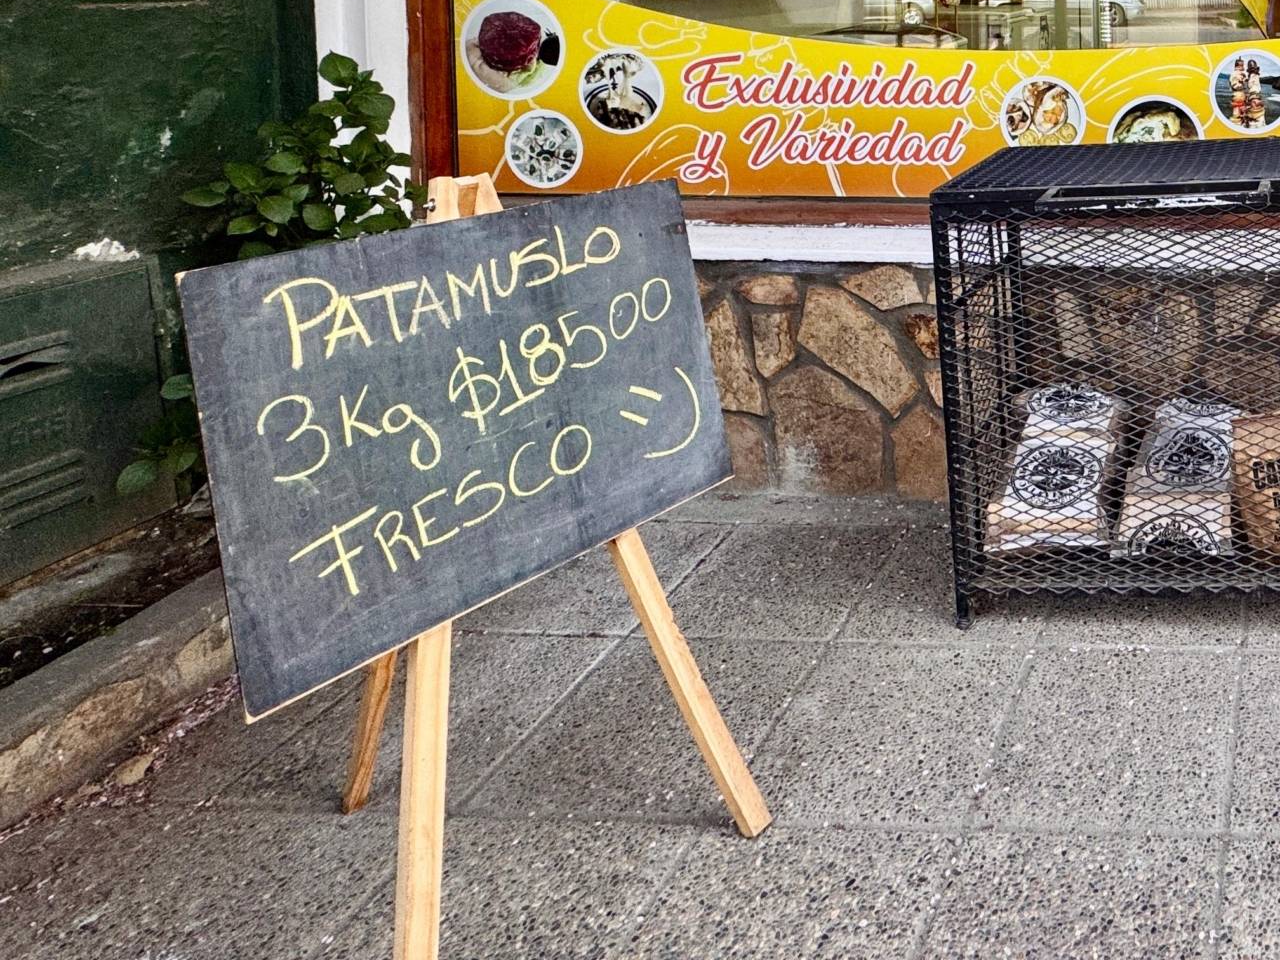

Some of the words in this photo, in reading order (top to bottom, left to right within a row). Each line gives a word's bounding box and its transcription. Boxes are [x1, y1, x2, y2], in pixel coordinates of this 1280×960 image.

[683, 54, 974, 110] Exclusividad
[683, 133, 724, 181] y
[742, 113, 964, 168] Variedad
[263, 225, 620, 369] PATAMUSLO
[449, 278, 671, 435] $18500
[289, 424, 592, 595] FRESCO
